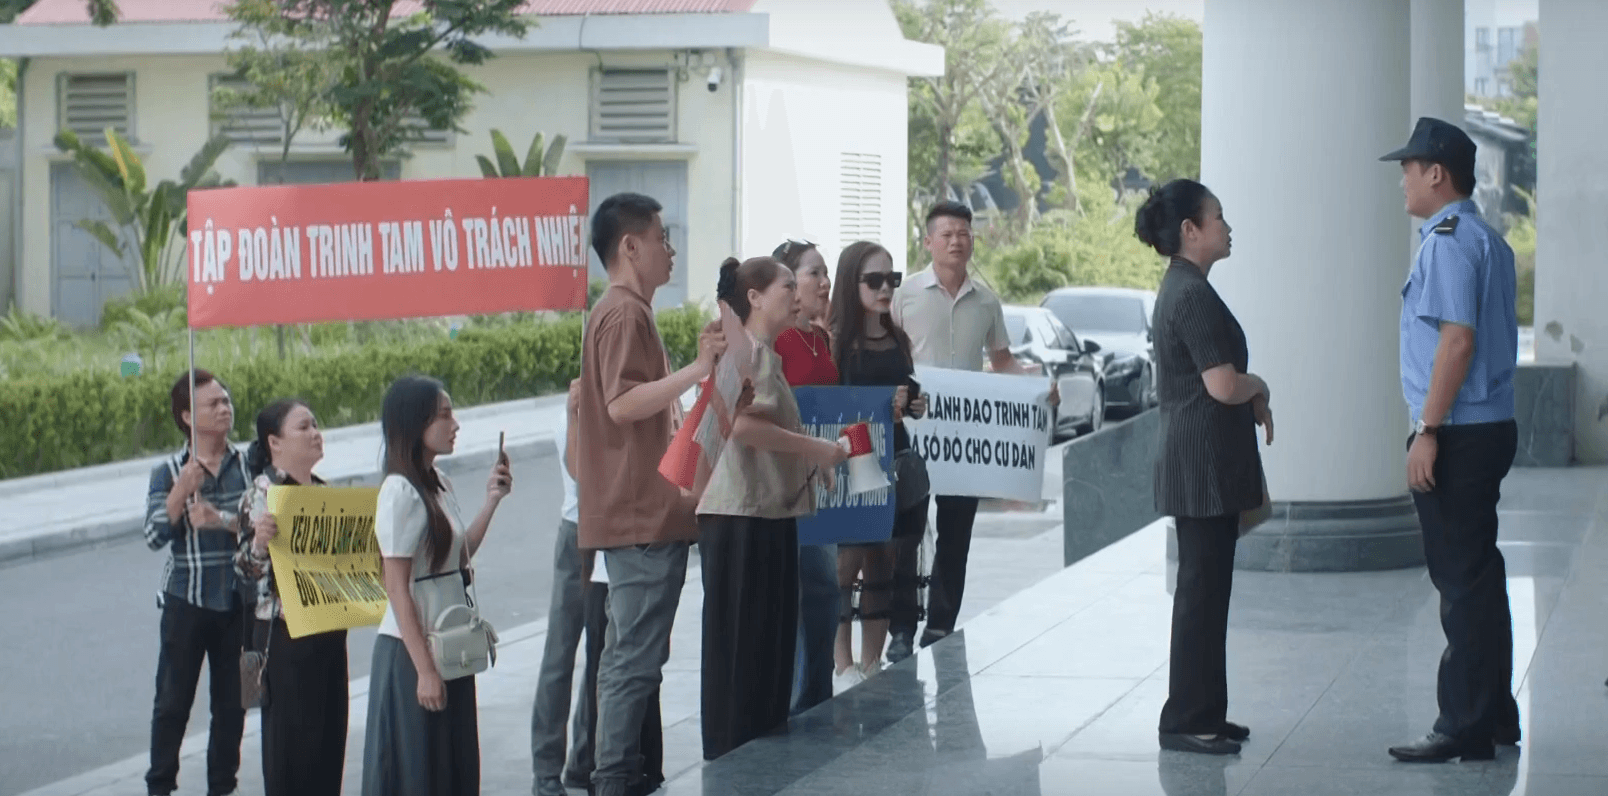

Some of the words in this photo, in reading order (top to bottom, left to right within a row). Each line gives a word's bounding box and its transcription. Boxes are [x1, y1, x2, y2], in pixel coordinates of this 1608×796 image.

[191, 218, 231, 295] TẬP
[238, 215, 301, 282] ĐOÀN
[307, 222, 373, 278] TRINH
[378, 218, 425, 274] TAM
[429, 208, 458, 272] VÔ
[463, 206, 532, 270] TRÁCH
[994, 400, 1030, 429] TRINH
[965, 437, 992, 466] CHO
